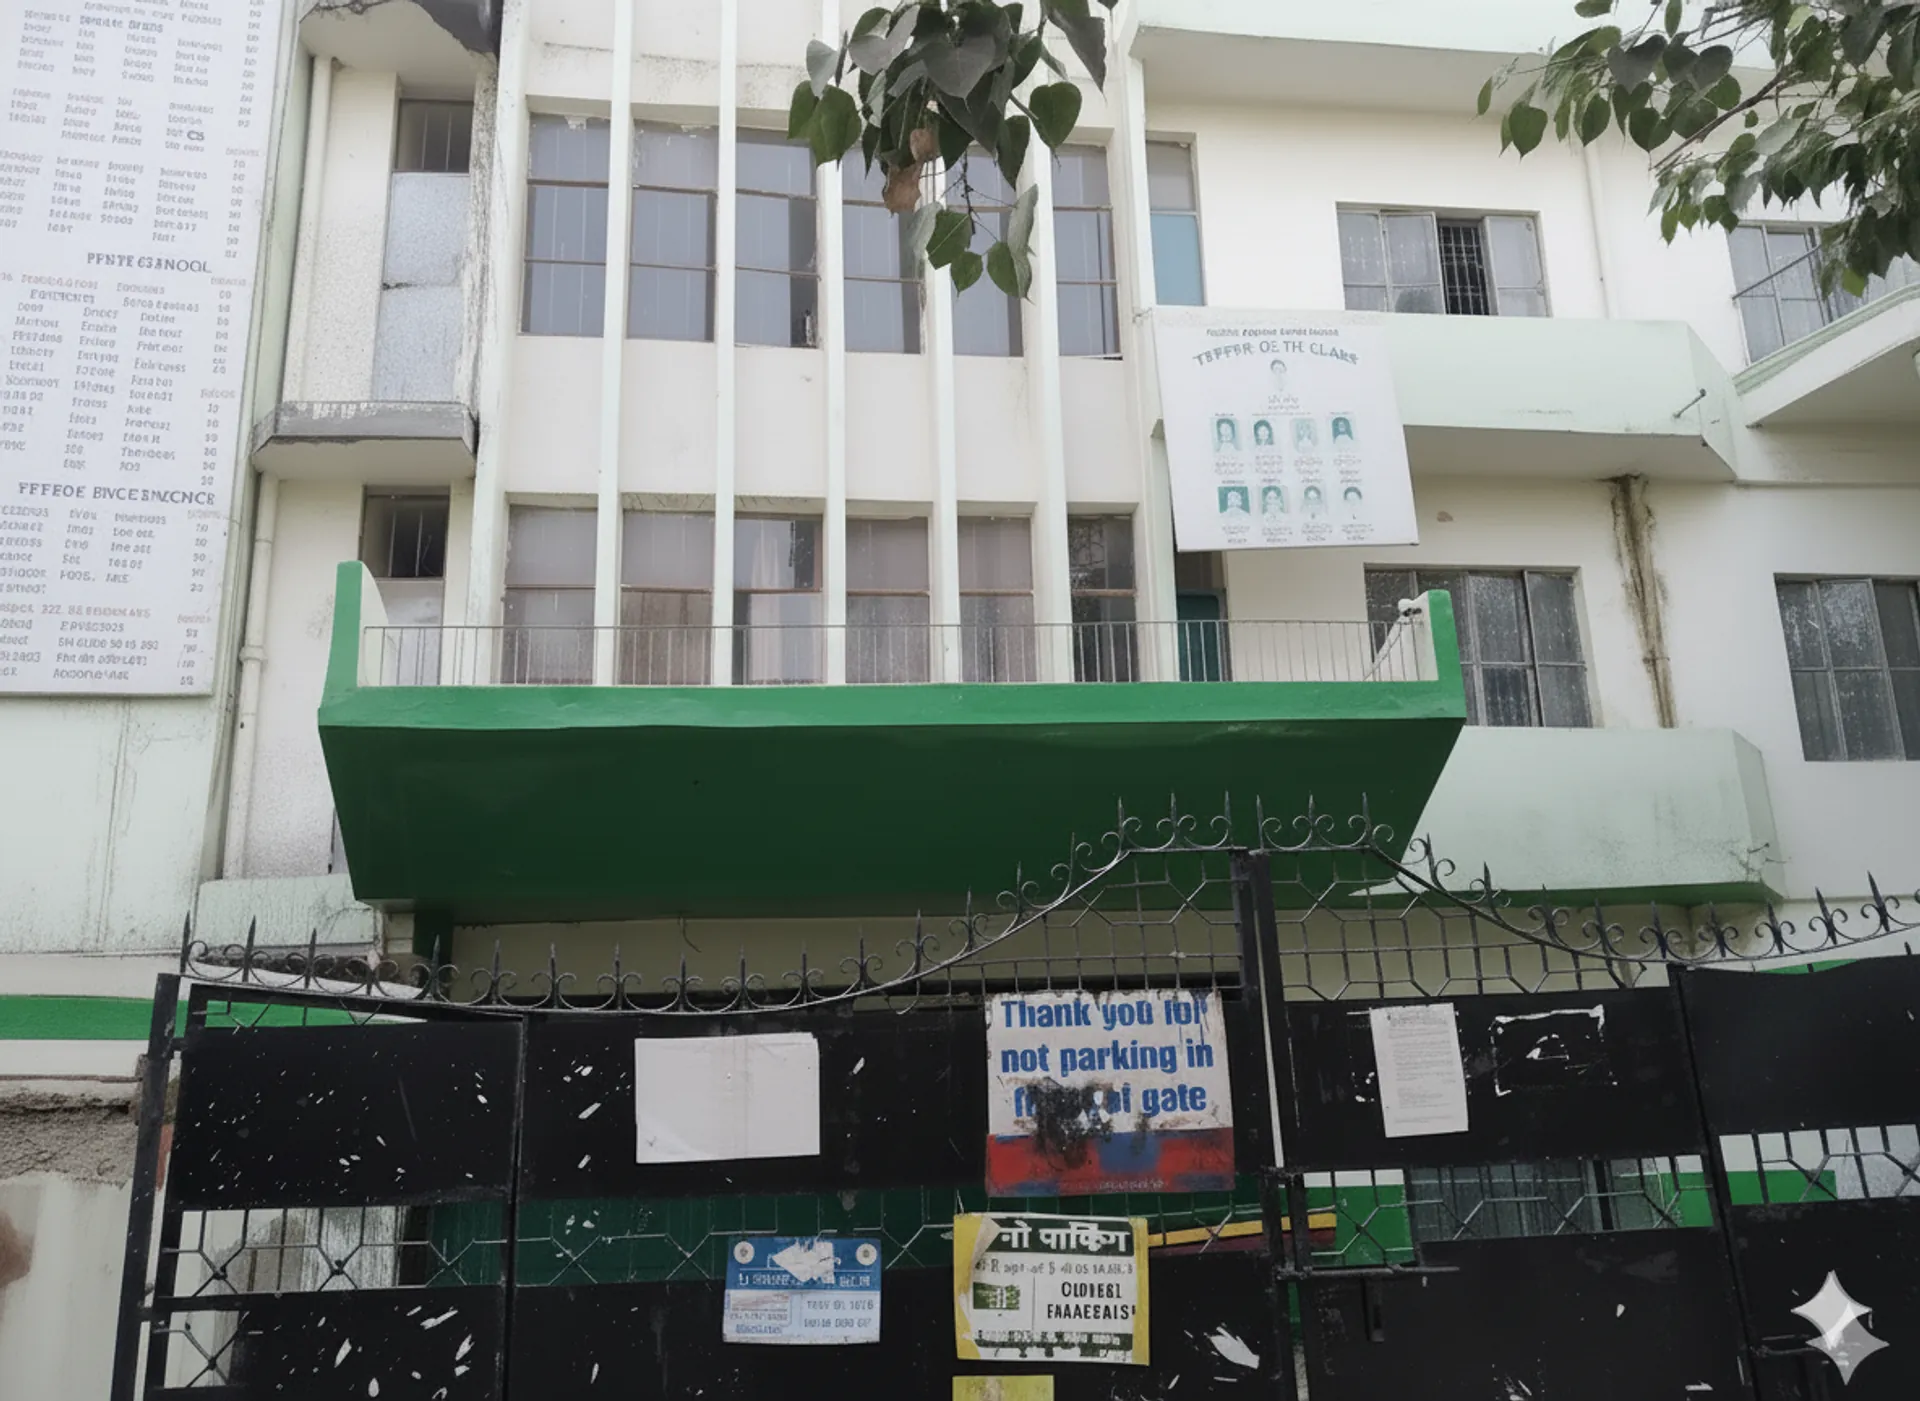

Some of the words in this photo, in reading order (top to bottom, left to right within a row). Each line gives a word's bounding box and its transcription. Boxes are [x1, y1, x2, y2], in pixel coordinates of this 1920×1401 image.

[1000, 999, 1091, 1028] Thank
[1102, 1000, 1154, 1031] you
[1001, 1044, 1050, 1073] not
[1060, 1039, 1178, 1078] parking
[1186, 1038, 1214, 1068] in
[1141, 1084, 1207, 1118] gate
